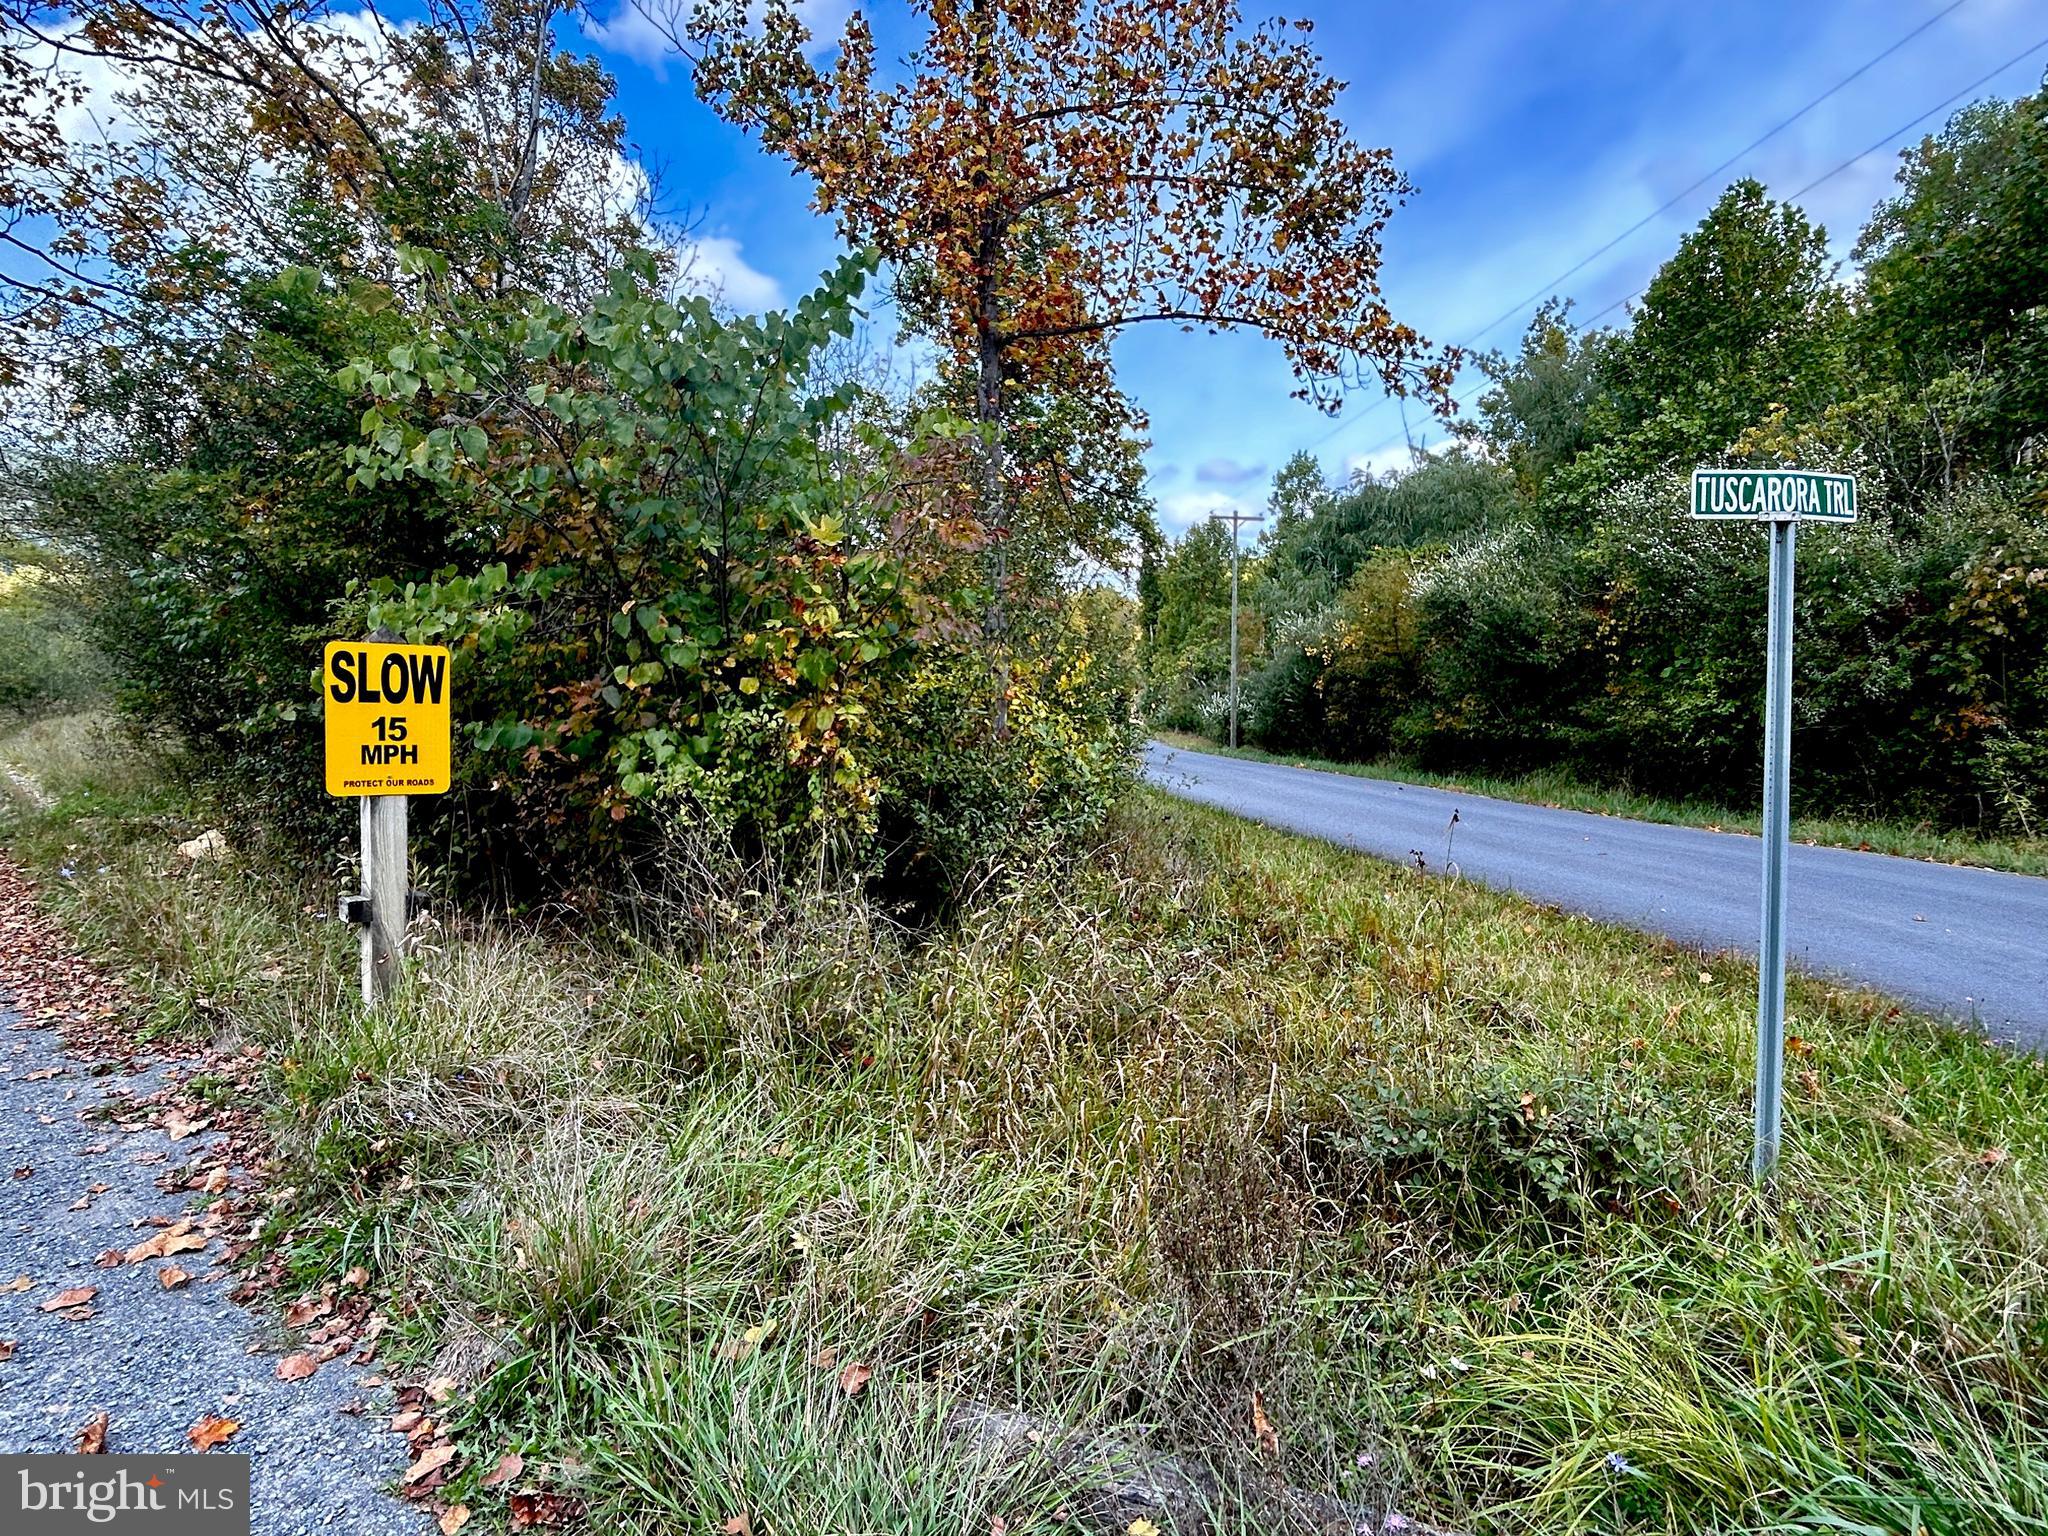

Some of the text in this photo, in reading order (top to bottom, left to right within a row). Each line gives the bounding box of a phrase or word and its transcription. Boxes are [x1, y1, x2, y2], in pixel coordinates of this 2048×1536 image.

[1698, 476, 1854, 515] TUSCARORA TRL
[330, 650, 446, 704] SLOW
[371, 716, 408, 742] 15
[361, 744, 418, 765] MPH
[343, 778, 435, 788] PROTECT OUR ROADS
